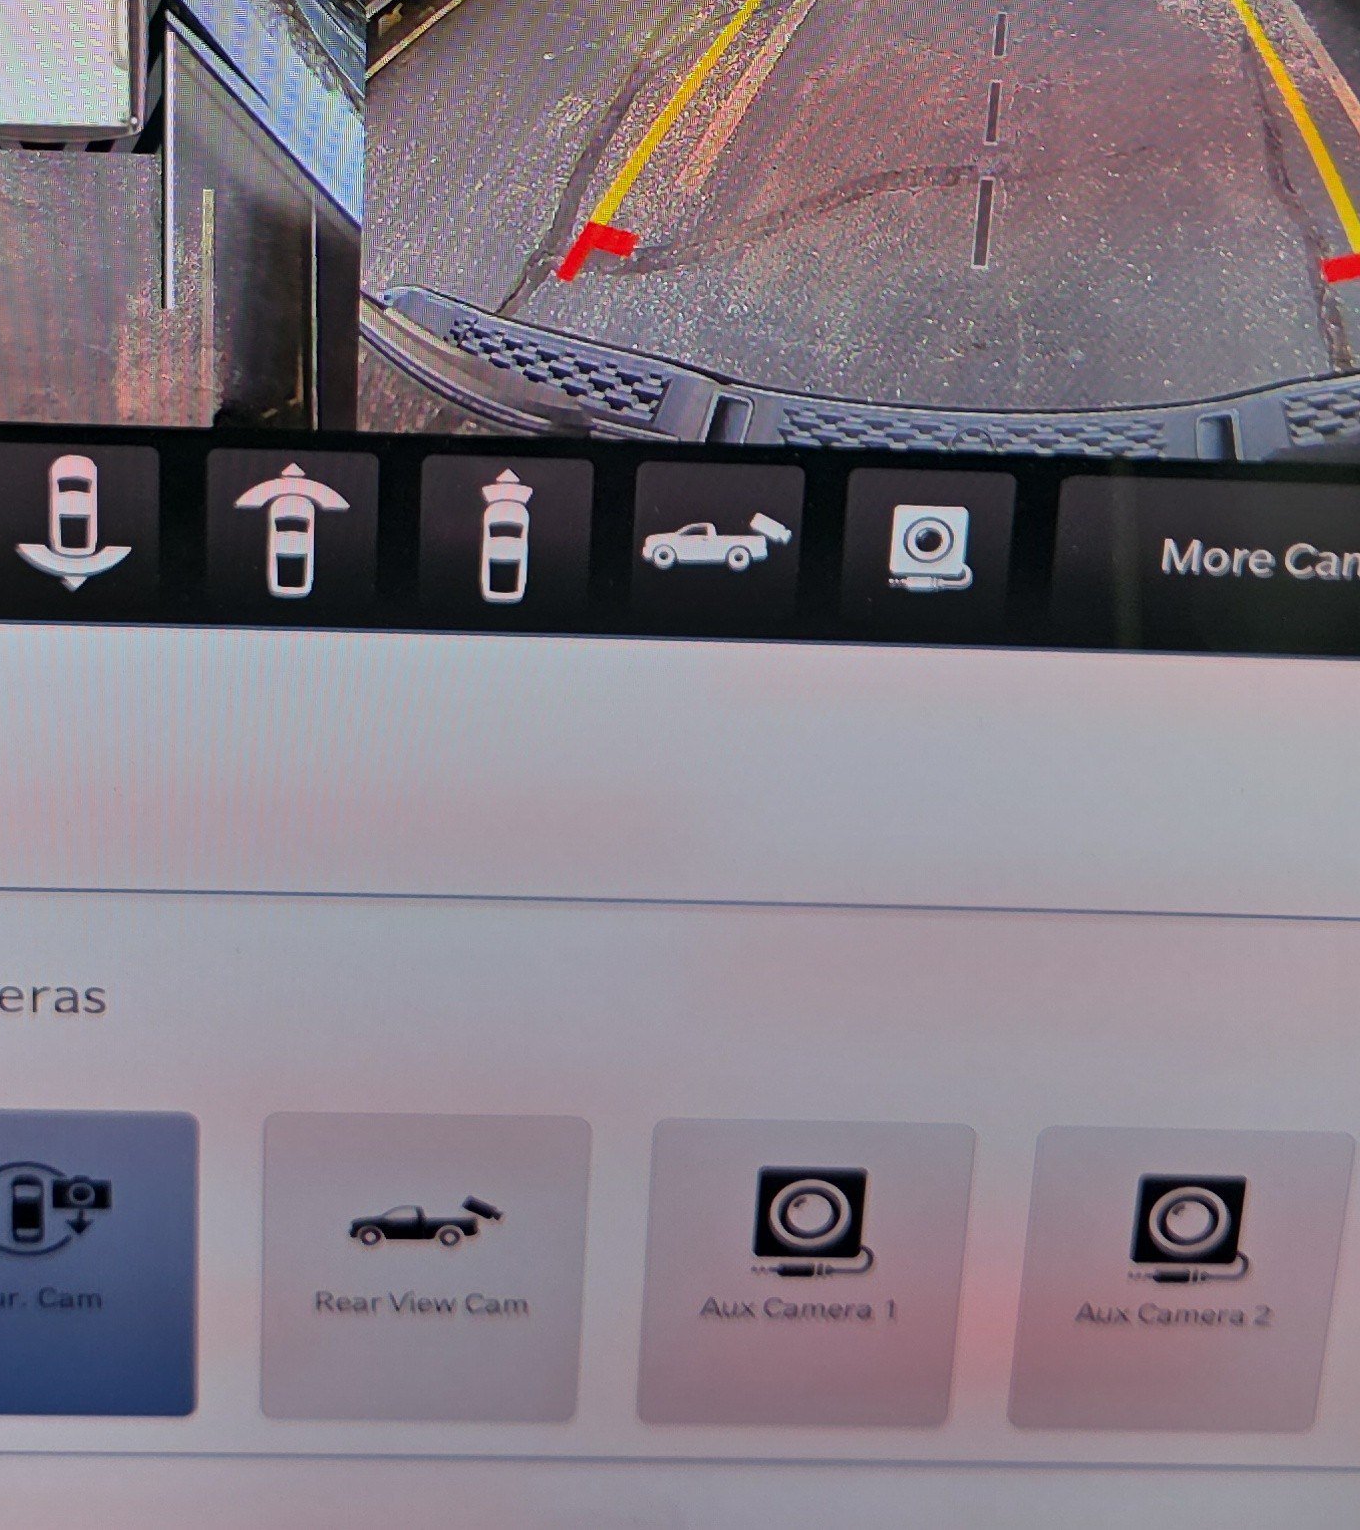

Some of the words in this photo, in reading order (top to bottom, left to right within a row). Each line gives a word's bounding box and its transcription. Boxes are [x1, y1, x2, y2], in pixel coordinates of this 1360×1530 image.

[1160, 537, 1276, 579] More
[38, 1286, 103, 1311] Cam
[314, 1290, 383, 1314] Rear
[388, 1291, 456, 1315] View
[464, 1292, 530, 1317] Cam
[700, 1296, 756, 1320] Aux
[762, 1298, 872, 1321] Camera
[883, 1299, 898, 1320] 1
[1076, 1301, 1131, 1324] Aux
[1138, 1303, 1244, 1327] Camera
[1254, 1304, 1274, 1327] 2
